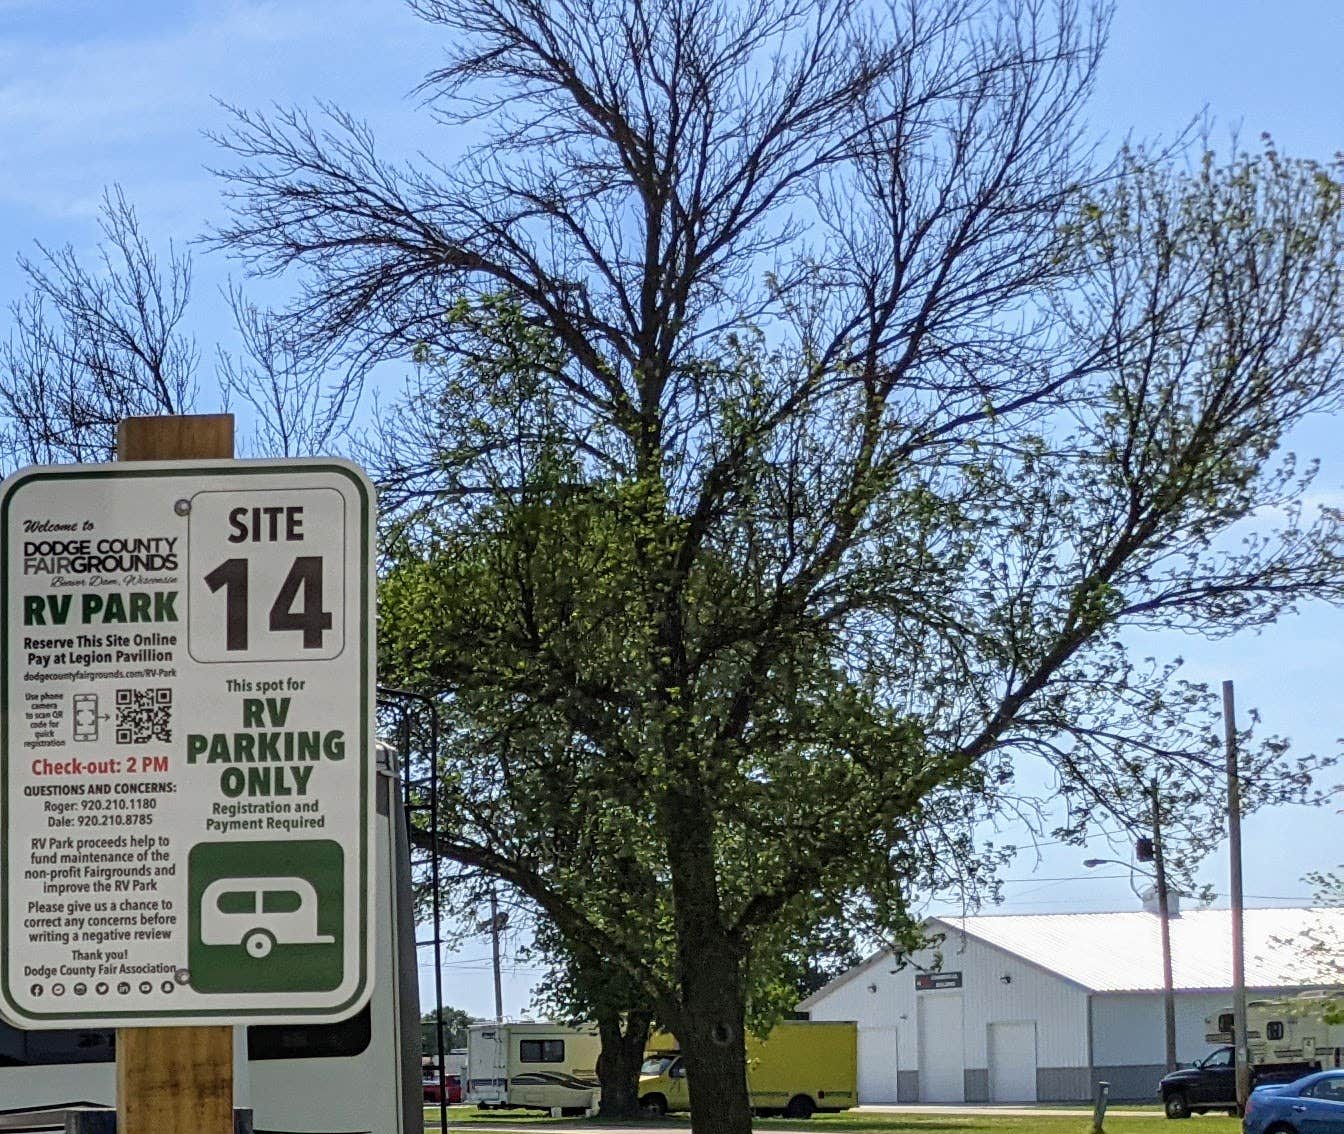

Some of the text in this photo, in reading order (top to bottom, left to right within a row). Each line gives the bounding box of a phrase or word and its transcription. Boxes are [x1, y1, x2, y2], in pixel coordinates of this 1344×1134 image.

[23, 520, 94, 533] Welcome to
[228, 507, 304, 544] SITE
[24, 537, 178, 557] DODGE COUNTY
[24, 554, 178, 575] FAIRGROUNDS
[123, 575, 177, 586] Wisconsin
[24, 592, 179, 626] RV PARK
[204, 556, 332, 651] 14
[24, 633, 177, 650] Reserve This Site Online
[28, 650, 173, 668] Pay at Legion Pavillion
[24, 669, 177, 683] dodgecountyfairgrounds.com/RV-Park
[226, 678, 306, 694] This spot for
[25, 693, 63, 702] Use phone
[52, 711, 63, 720] QR
[243, 698, 292, 729] RV
[35, 730, 55, 739] quick
[24, 739, 66, 749] registration
[187, 730, 345, 764] PARKING
[32, 757, 169, 776] Check-out: 2 PM
[24, 783, 177, 796] QUESTIONS AND CONCERNS:
[220, 766, 314, 798] ONLY
[44, 799, 157, 814] Roger: 920.210.1180
[213, 800, 319, 818] Registration and
[48, 814, 153, 827] Dale: 920.210.8785
[206, 816, 325, 834] Payment Required
[31, 835, 170, 851] RV Park proceeds help to
[31, 850, 170, 864] fund maintenance of the
[25, 864, 176, 881] non-profit Fairgrounds and
[44, 879, 157, 896] improve the RV Park
[28, 899, 172, 915] Please give us a chance to
[24, 913, 177, 930] correct any concerns before
[29, 928, 171, 945] writing a negative review
[72, 950, 128, 963] Thank you!
[24, 963, 177, 979] Dodge County Fair Association
